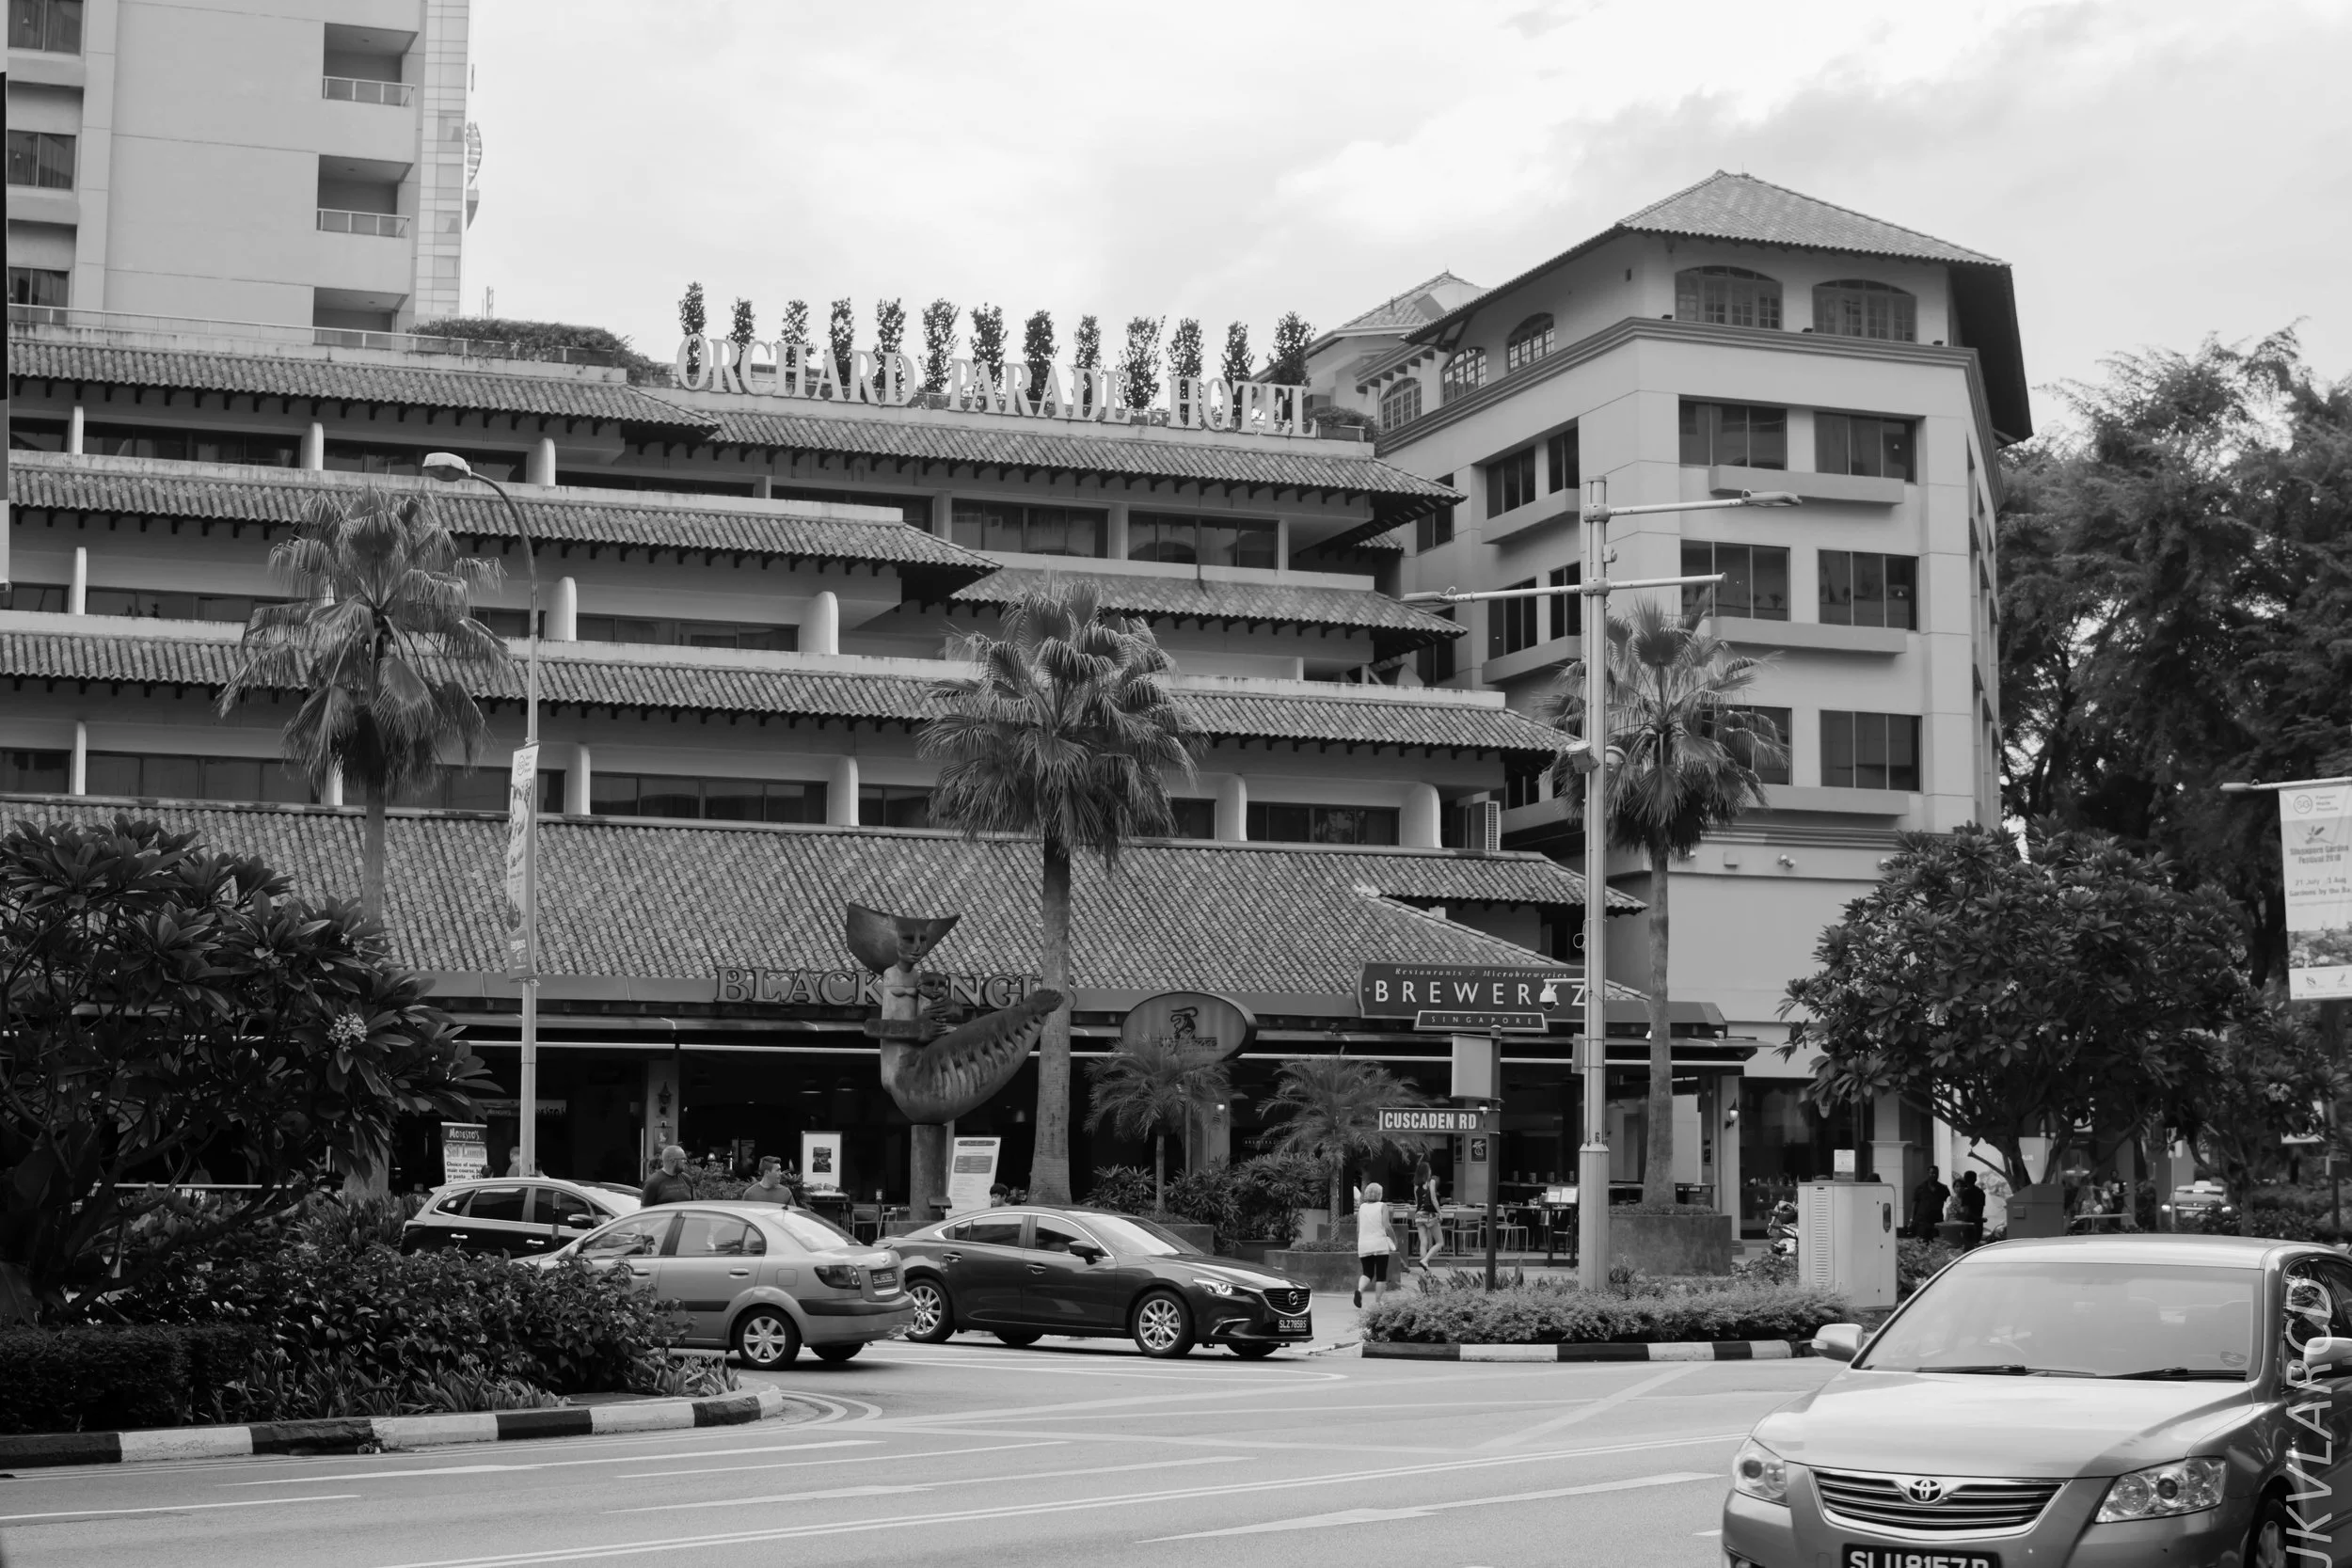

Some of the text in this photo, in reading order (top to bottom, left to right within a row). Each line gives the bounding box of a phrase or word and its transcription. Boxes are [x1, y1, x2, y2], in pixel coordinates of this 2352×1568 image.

[676, 334, 1317, 438] ORCHARD PARADE HOTEL
[1395, 967, 1463, 977] Restaurants
[1483, 970, 1568, 979] Microbreweries
[714, 966, 884, 1006] BLACK
[1431, 1016, 1533, 1024] SINGAPORE
[1385, 1112, 1477, 1129] CUSCADEN RD
